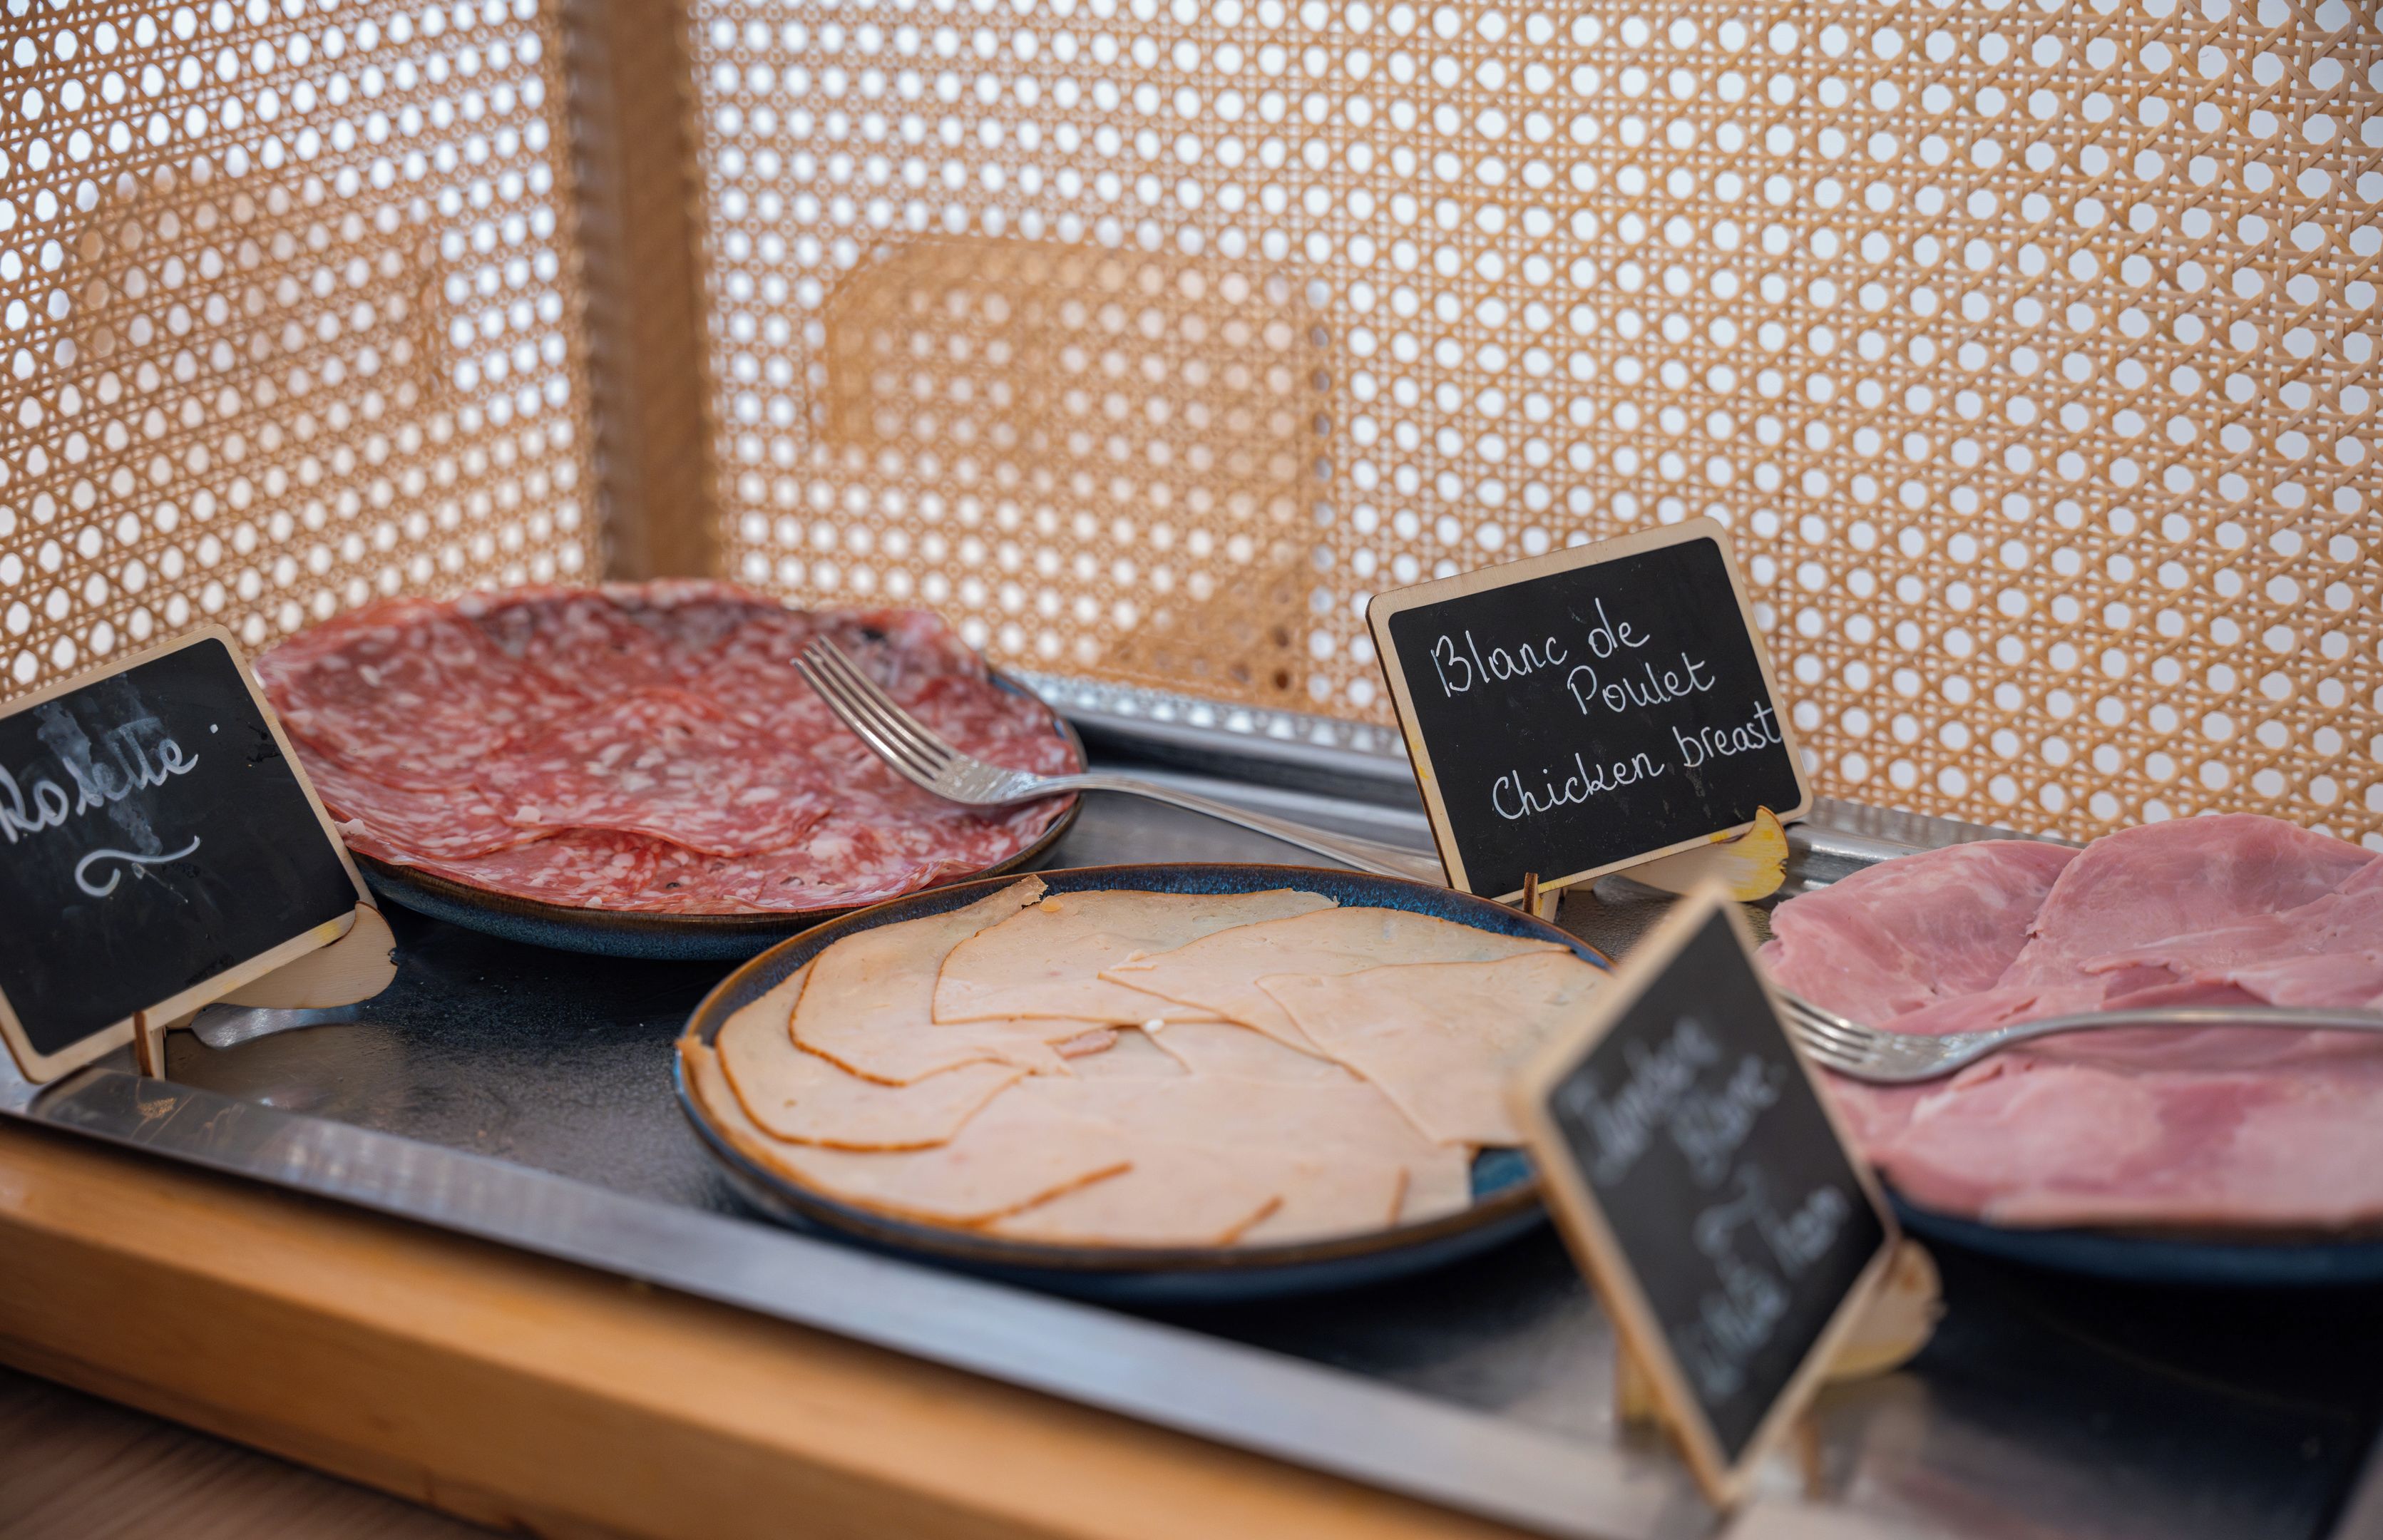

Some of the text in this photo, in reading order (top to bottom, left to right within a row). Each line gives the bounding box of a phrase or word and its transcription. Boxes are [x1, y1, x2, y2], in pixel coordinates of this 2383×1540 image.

[1430, 597, 1650, 697] Blanc de
[1567, 652, 1716, 715] Poulet
[1492, 702, 1783, 820] Chicken breast
